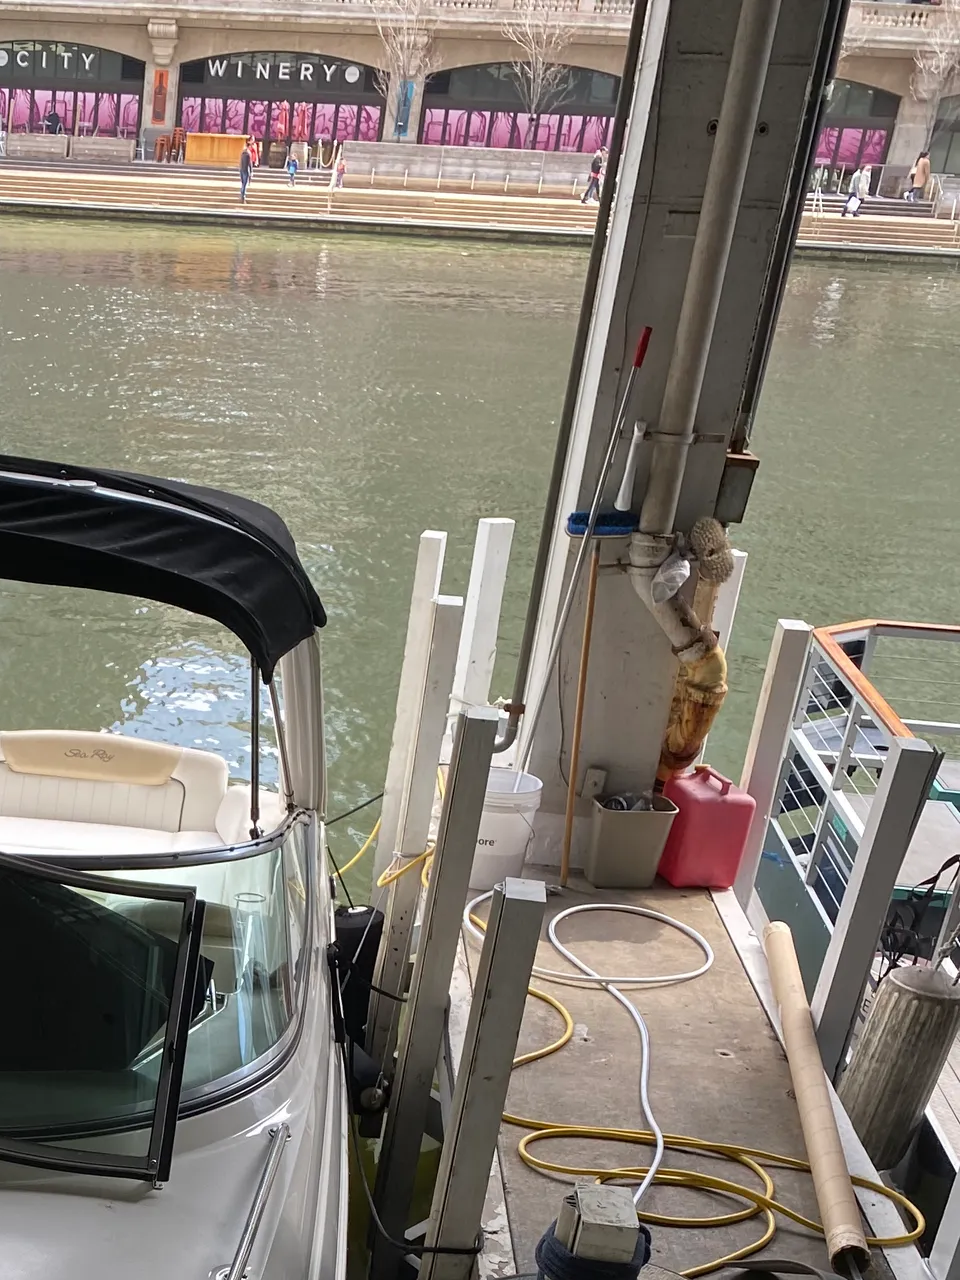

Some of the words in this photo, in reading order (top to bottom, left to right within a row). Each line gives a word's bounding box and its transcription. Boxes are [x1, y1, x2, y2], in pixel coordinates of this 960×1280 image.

[16, 50, 95, 71] CITY
[208, 59, 337, 82] WINERY
[63, 748, 89, 759] Sea
[90, 748, 116, 763] Ray
